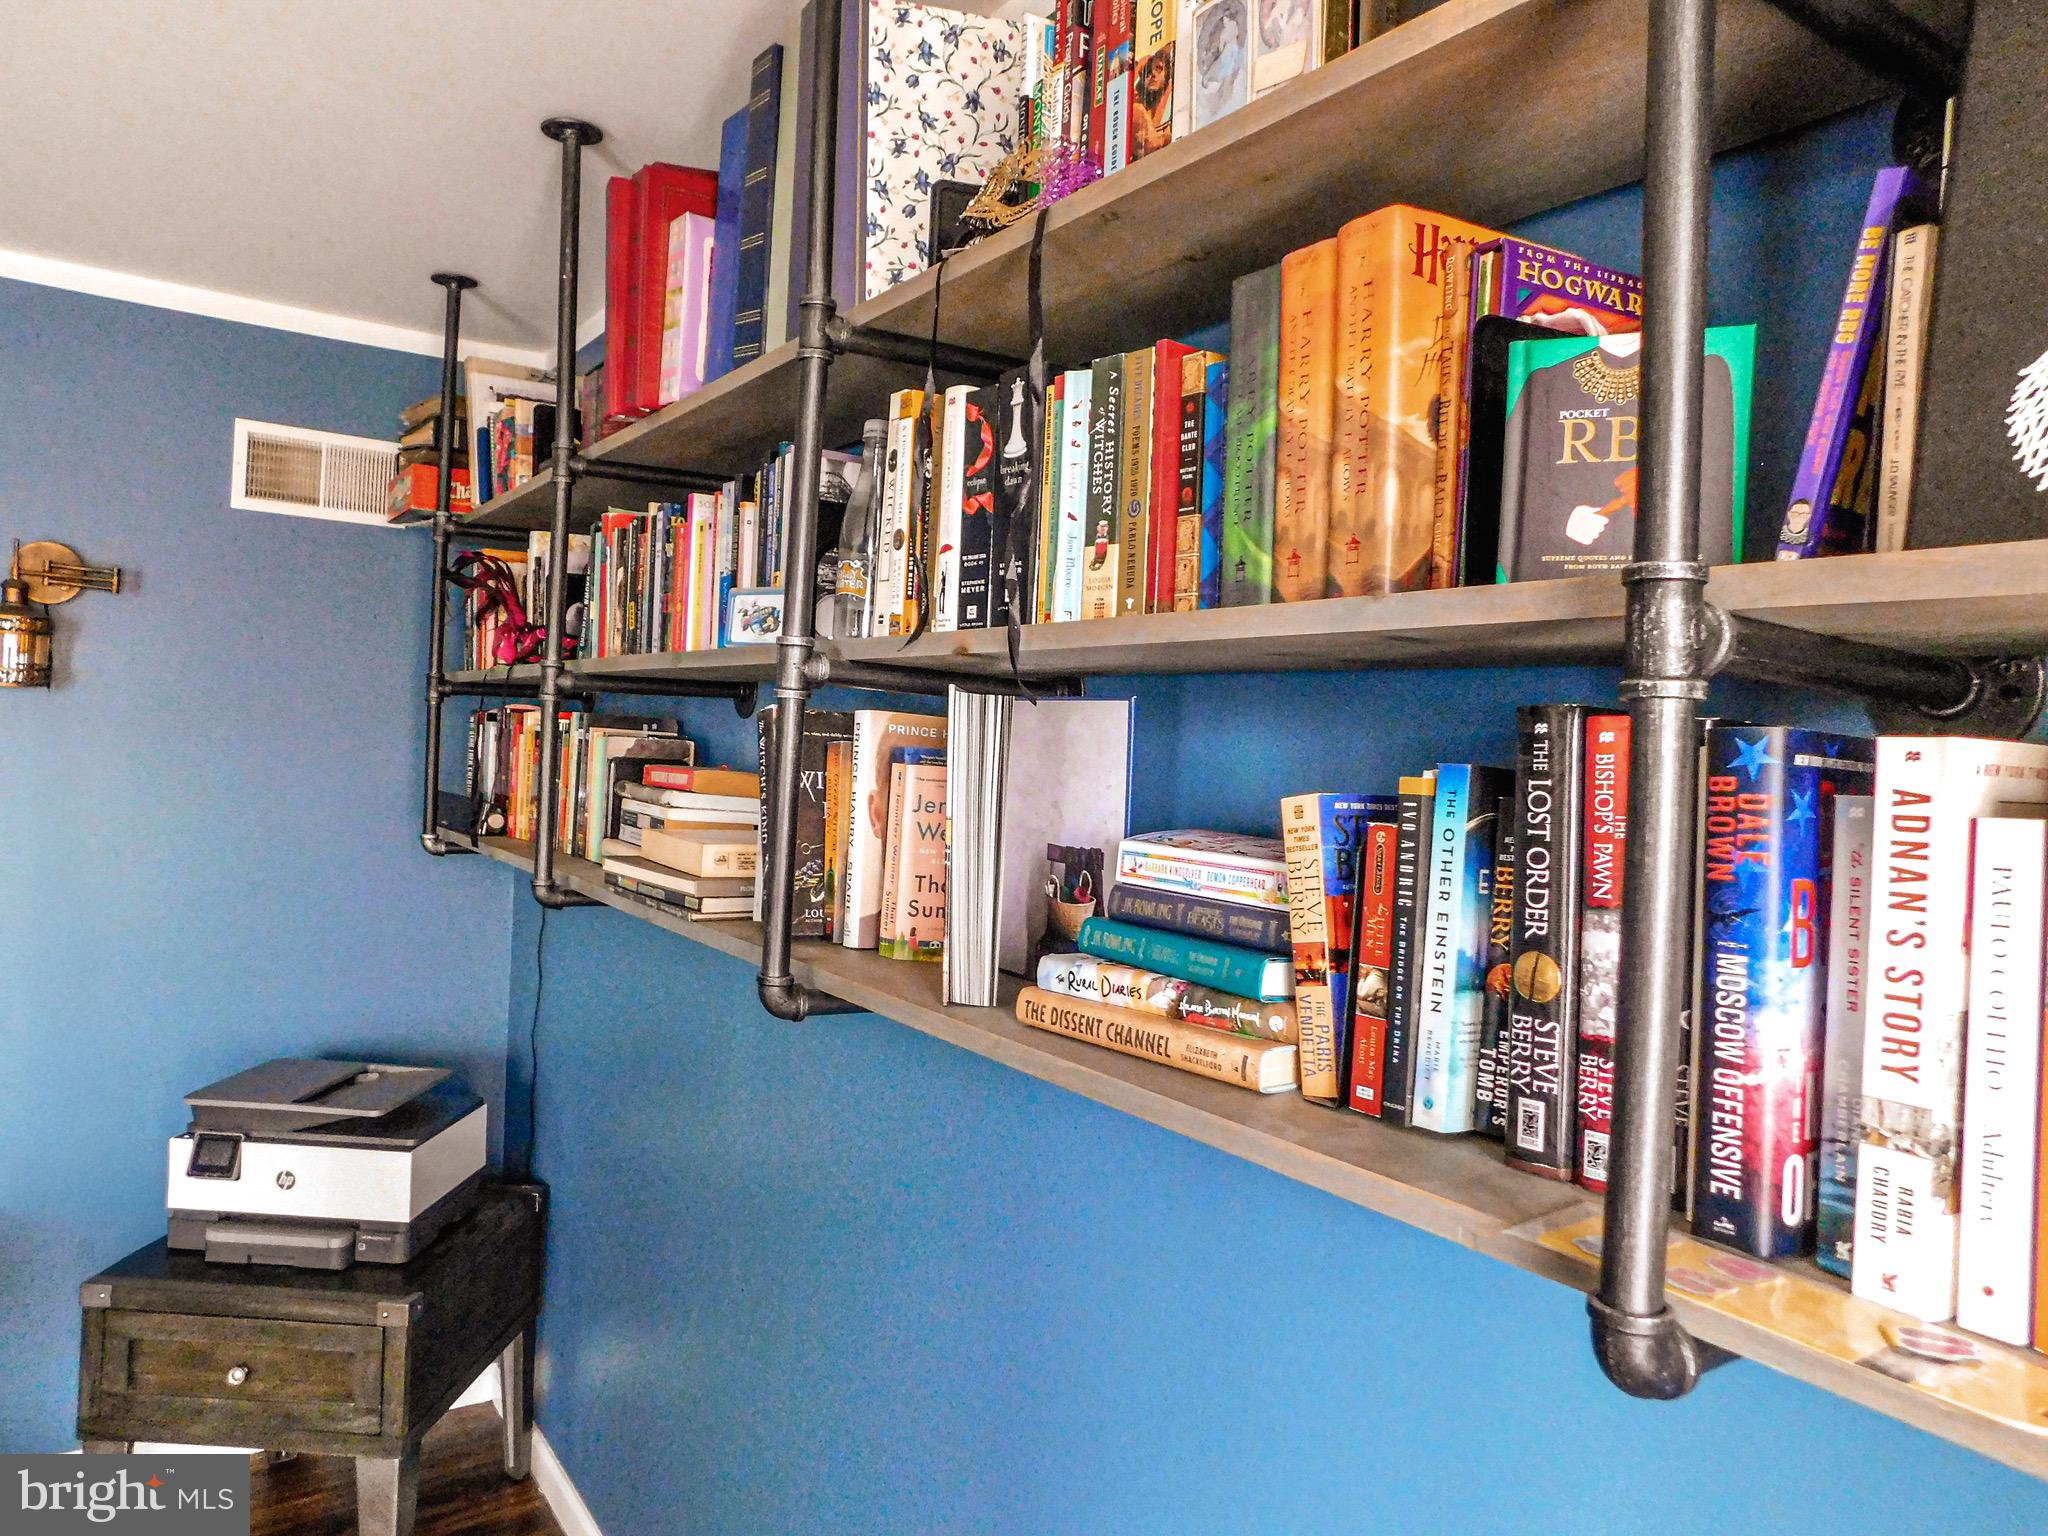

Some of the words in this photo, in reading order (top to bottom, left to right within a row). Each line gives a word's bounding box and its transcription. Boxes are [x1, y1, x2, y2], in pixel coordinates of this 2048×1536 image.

[1150, 0, 1163, 46] OPE
[1063, 82, 1072, 124] Guide
[1111, 111, 1119, 140] ROUGH
[1110, 143, 1118, 172] GUIDE
[1517, 246, 1557, 265] FROM
[1564, 259, 1590, 274] THE
[1860, 225, 1886, 250] BE
[1845, 254, 1877, 305] MORE
[1898, 277, 1913, 333] CATCHER
[1360, 280, 1374, 381] HARRY
[1834, 308, 1863, 345] RBG
[1109, 370, 1119, 380] A
[1298, 310, 1312, 404] HARRY
[1106, 386, 1120, 434] Secret
[1559, 408, 1611, 420] POCKET
[1000, 461, 1032, 475] breaking
[1089, 417, 1109, 495] WITCHES
[1130, 425, 1140, 456] POEMS
[1294, 419, 1309, 514] POTTER
[1355, 395, 1371, 497] POTTER
[1102, 440, 1116, 516] HISTORY
[1243, 432, 1255, 522] POTTER
[882, 478, 895, 554] WICKED
[1128, 521, 1138, 550] PABLO
[961, 585, 985, 594] MEYER
[1125, 552, 1137, 589] NERUDA
[853, 722, 861, 784] PRINCE
[888, 723, 938, 739] PRINCE
[1533, 740, 1549, 772] THE
[759, 736, 767, 800] WITCH'S
[1594, 753, 1616, 835] BISHOP'S
[760, 805, 768, 845] KIND
[848, 791, 857, 848] HARRY
[1401, 801, 1418, 832] IVO
[1445, 789, 1458, 819] THE
[1526, 779, 1552, 842] LOST
[1705, 775, 1740, 882] BROWN
[1736, 793, 1773, 868] DALE
[844, 861, 853, 914] SPARE
[1206, 870, 1227, 884] DEMON
[1227, 873, 1266, 890] COPPERHEAD
[1437, 828, 1456, 902] OTHER
[1591, 842, 1614, 900] PAWN
[1886, 788, 1933, 949] ADNAN'S
[883, 890, 893, 933] Summer
[1287, 859, 1307, 936] BERRY
[1304, 857, 1324, 934] STEVE
[1490, 866, 1514, 951] BERRY
[1524, 847, 1549, 940] ORDER
[1848, 876, 1862, 941] SILENT
[1398, 916, 1408, 937] THE
[1395, 940, 1406, 981] BRIDGE
[1429, 911, 1450, 1014] EINSTEIN
[1846, 947, 1859, 1013] SISTER
[1315, 999, 1327, 1020] THE
[1393, 1006, 1403, 1026] THE
[1394, 985, 1404, 1000] ON
[1713, 952, 1748, 1065] MOSCOW
[1024, 1000, 1046, 1022] THE
[1050, 1006, 1103, 1039] DISSENT
[1105, 1022, 1172, 1059] CHANNEL
[1185, 1043, 1218, 1060] ELIZABETH
[1298, 993, 1317, 1078] VENDETTA
[1315, 1023, 1333, 1074] PARIS
[1391, 1030, 1402, 1064] DRINA
[1511, 1014, 1535, 1090] BERRY
[1877, 965, 1925, 1085] STORY
[1180, 1054, 1223, 1073] SHACKELFORD
[1476, 1047, 1498, 1102] TOMB
[1532, 1018, 1560, 1097] STEVE
[1577, 1053, 1600, 1122] BERRY
[1596, 1057, 1615, 1121] STEVE
[1709, 1066, 1745, 1201] OFFENSIVE
[278, 1171, 296, 1190] hp
[1869, 1166, 1891, 1245] CHAUDRY
[1895, 1186, 1915, 1236] RABIA
